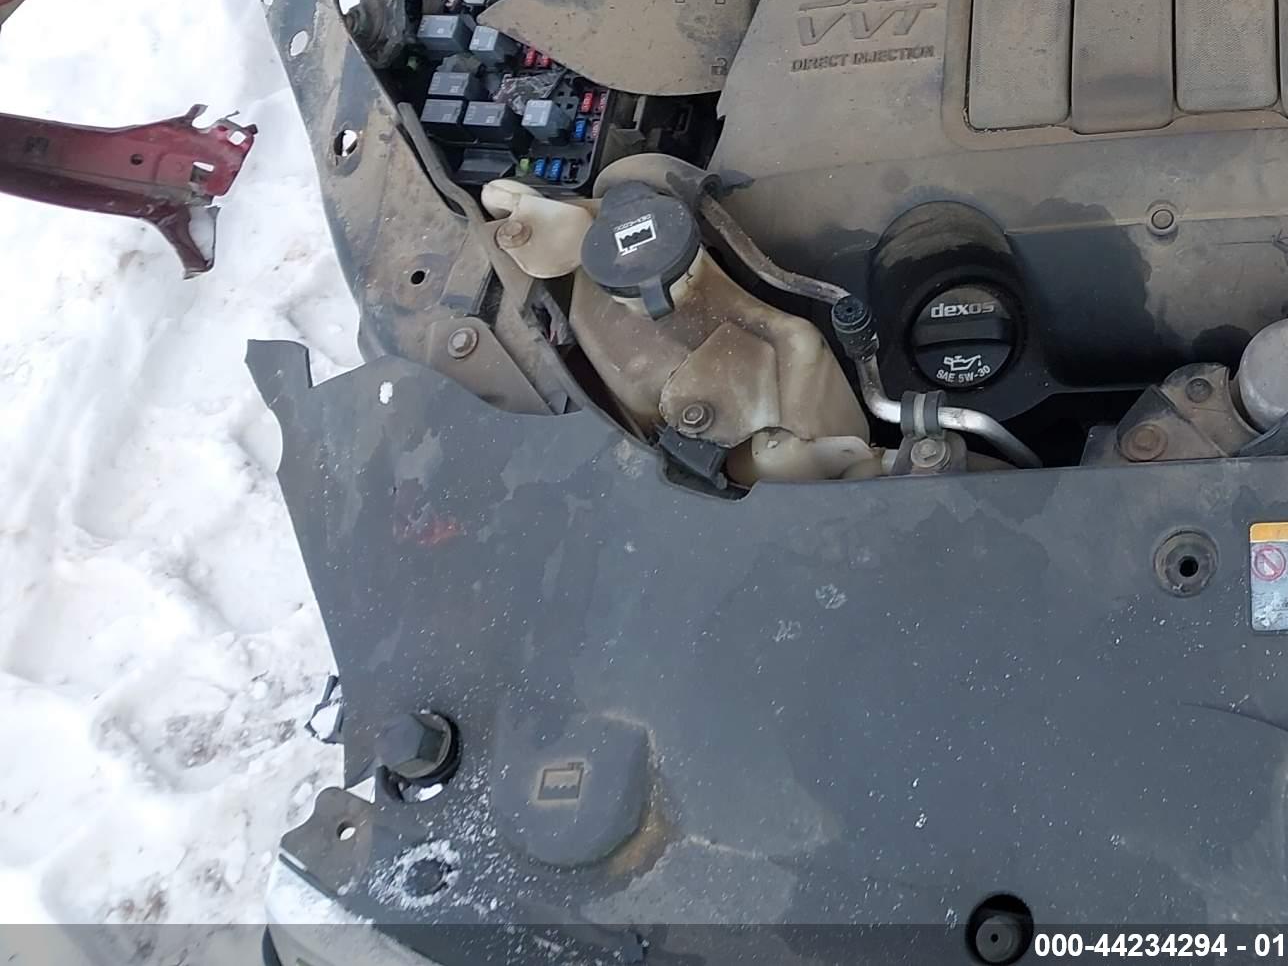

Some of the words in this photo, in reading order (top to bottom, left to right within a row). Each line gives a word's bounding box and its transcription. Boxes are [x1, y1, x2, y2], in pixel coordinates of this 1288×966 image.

[798, 3, 938, 47] VVT
[791, 54, 849, 73] DIRECT
[853, 45, 935, 65] INJECTION
[931, 301, 996, 318] dexos
[936, 369, 956, 383] SAE
[958, 365, 991, 383] 5W-30
